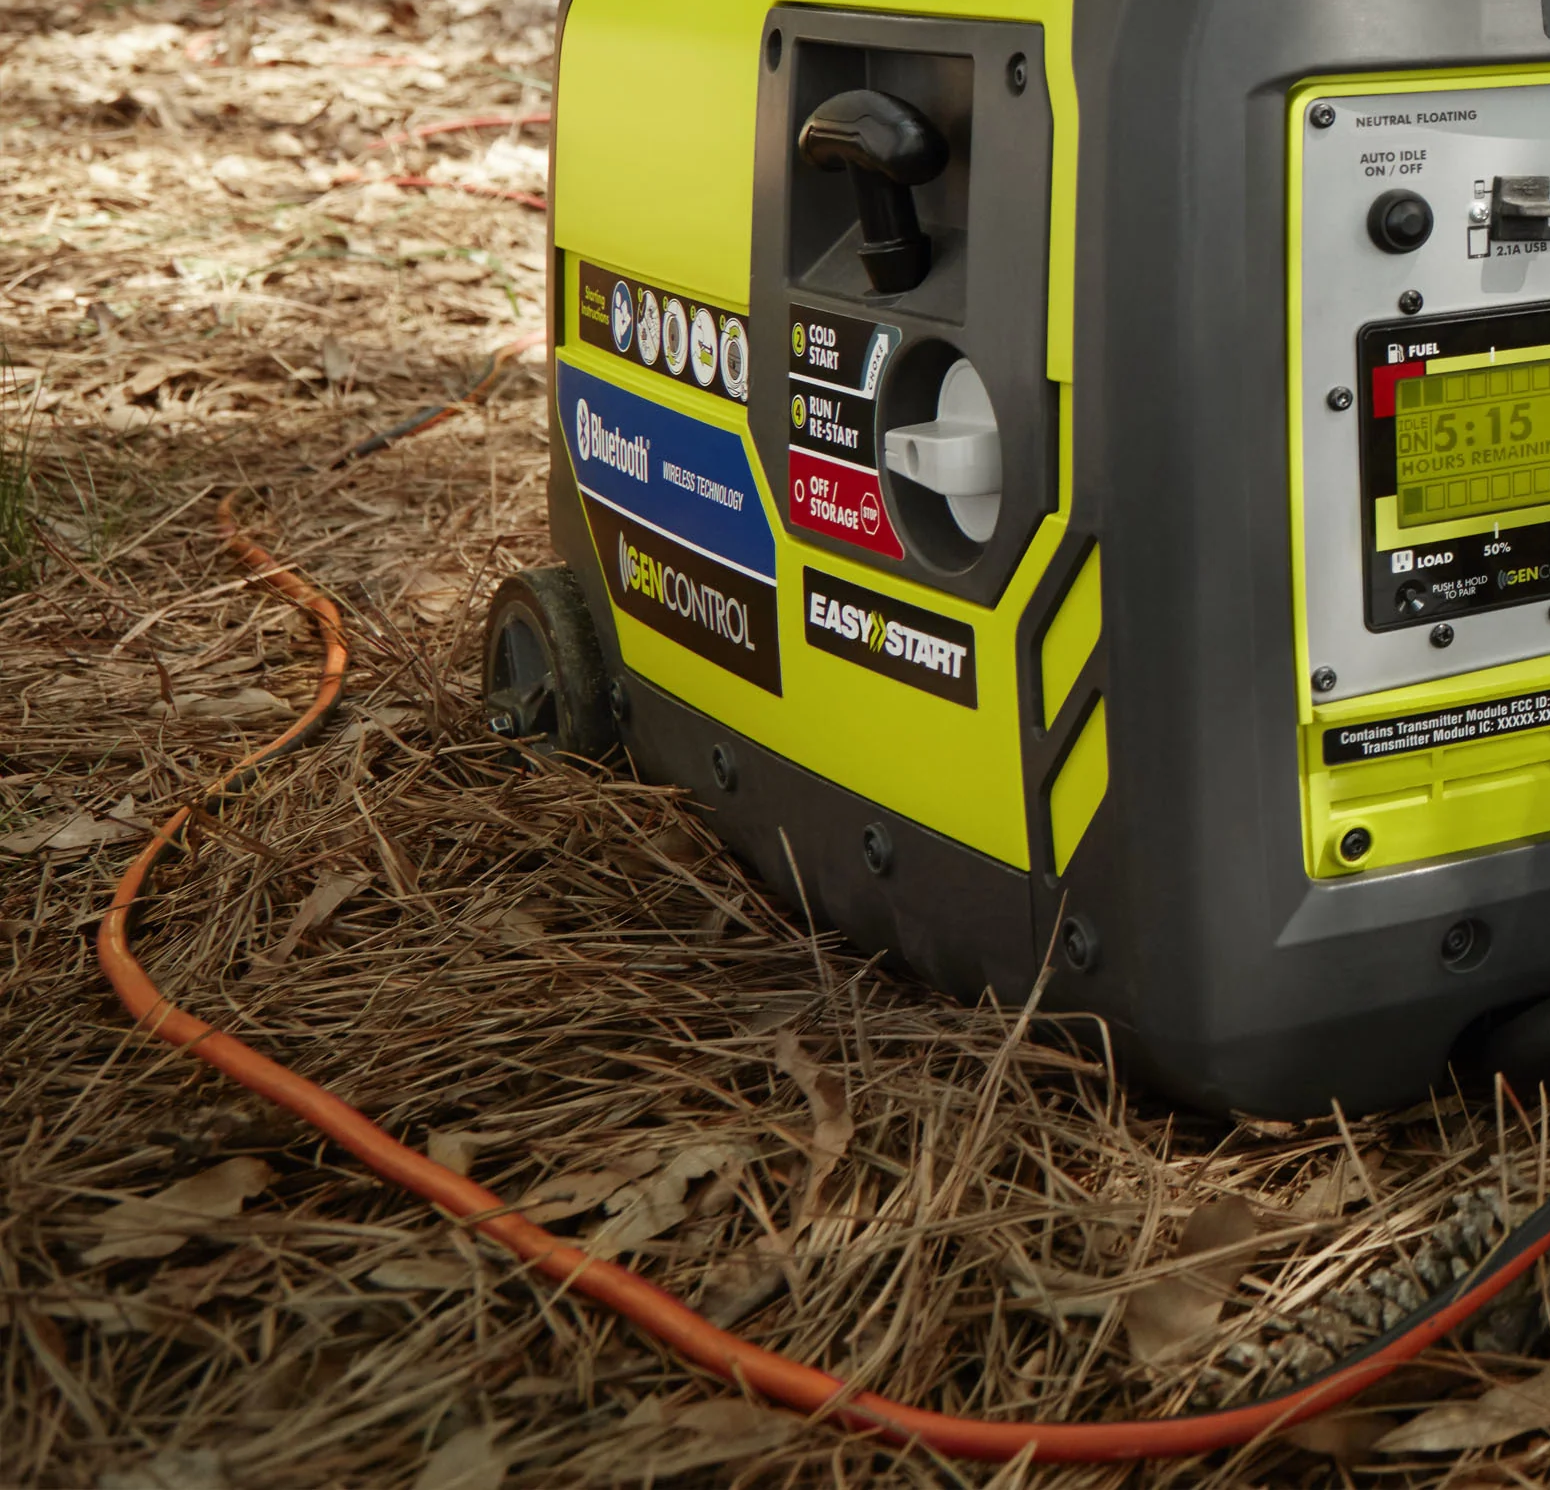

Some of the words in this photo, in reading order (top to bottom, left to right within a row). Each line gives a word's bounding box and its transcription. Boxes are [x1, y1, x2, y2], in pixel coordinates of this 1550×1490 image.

[1356, 114, 1412, 128] NEUTRAL
[1417, 110, 1477, 124] FLOATING
[1360, 152, 1395, 164] AUTO
[1400, 150, 1427, 162] IDLE
[1365, 165, 1385, 177] ON
[1389, 165, 1396, 177] /
[1399, 163, 1423, 174] OFF
[1496, 244, 1521, 256] 2.1A
[1525, 242, 1548, 253] USB
[585, 285, 606, 306] Starting
[796, 331, 802, 348] 2
[808, 324, 836, 347] COLD
[809, 345, 839, 370] START
[1408, 343, 1440, 358] FUEL
[795, 403, 802, 421] 4
[809, 396, 832, 419] RUN
[809, 417, 859, 449] RE-START
[1398, 417, 1428, 432] IDLE
[1434, 402, 1533, 453] 5:15
[1399, 430, 1429, 454] ON
[1401, 454, 1465, 477] HOURS
[663, 461, 695, 493] WIRELESS
[696, 475, 744, 512] TECHNOLOGY
[810, 476, 829, 499] OFF
[810, 497, 859, 530] STORAGE
[863, 506, 878, 521] STOP
[1417, 552, 1454, 569] LOAD
[1483, 542, 1511, 557] 50%
[1432, 581, 1455, 593] PUSH
[1457, 579, 1463, 589] &
[1465, 576, 1488, 588] HOLD
[1445, 590, 1457, 600] TO
[1458, 587, 1476, 598] PAIR
[628, 545, 755, 652] GENCONTROL
[810, 592, 873, 644] EASY
[884, 621, 967, 679] START
[1341, 725, 1393, 745] Contains
[1396, 710, 1464, 735] Transmitter
[1466, 704, 1508, 723] Module
[1510, 699, 1534, 715] FCC
[1535, 696, 1550, 711] ID:
[1362, 734, 1430, 755] Transmitter
[1433, 725, 1476, 744] Module
[1479, 720, 1494, 735] IC:
